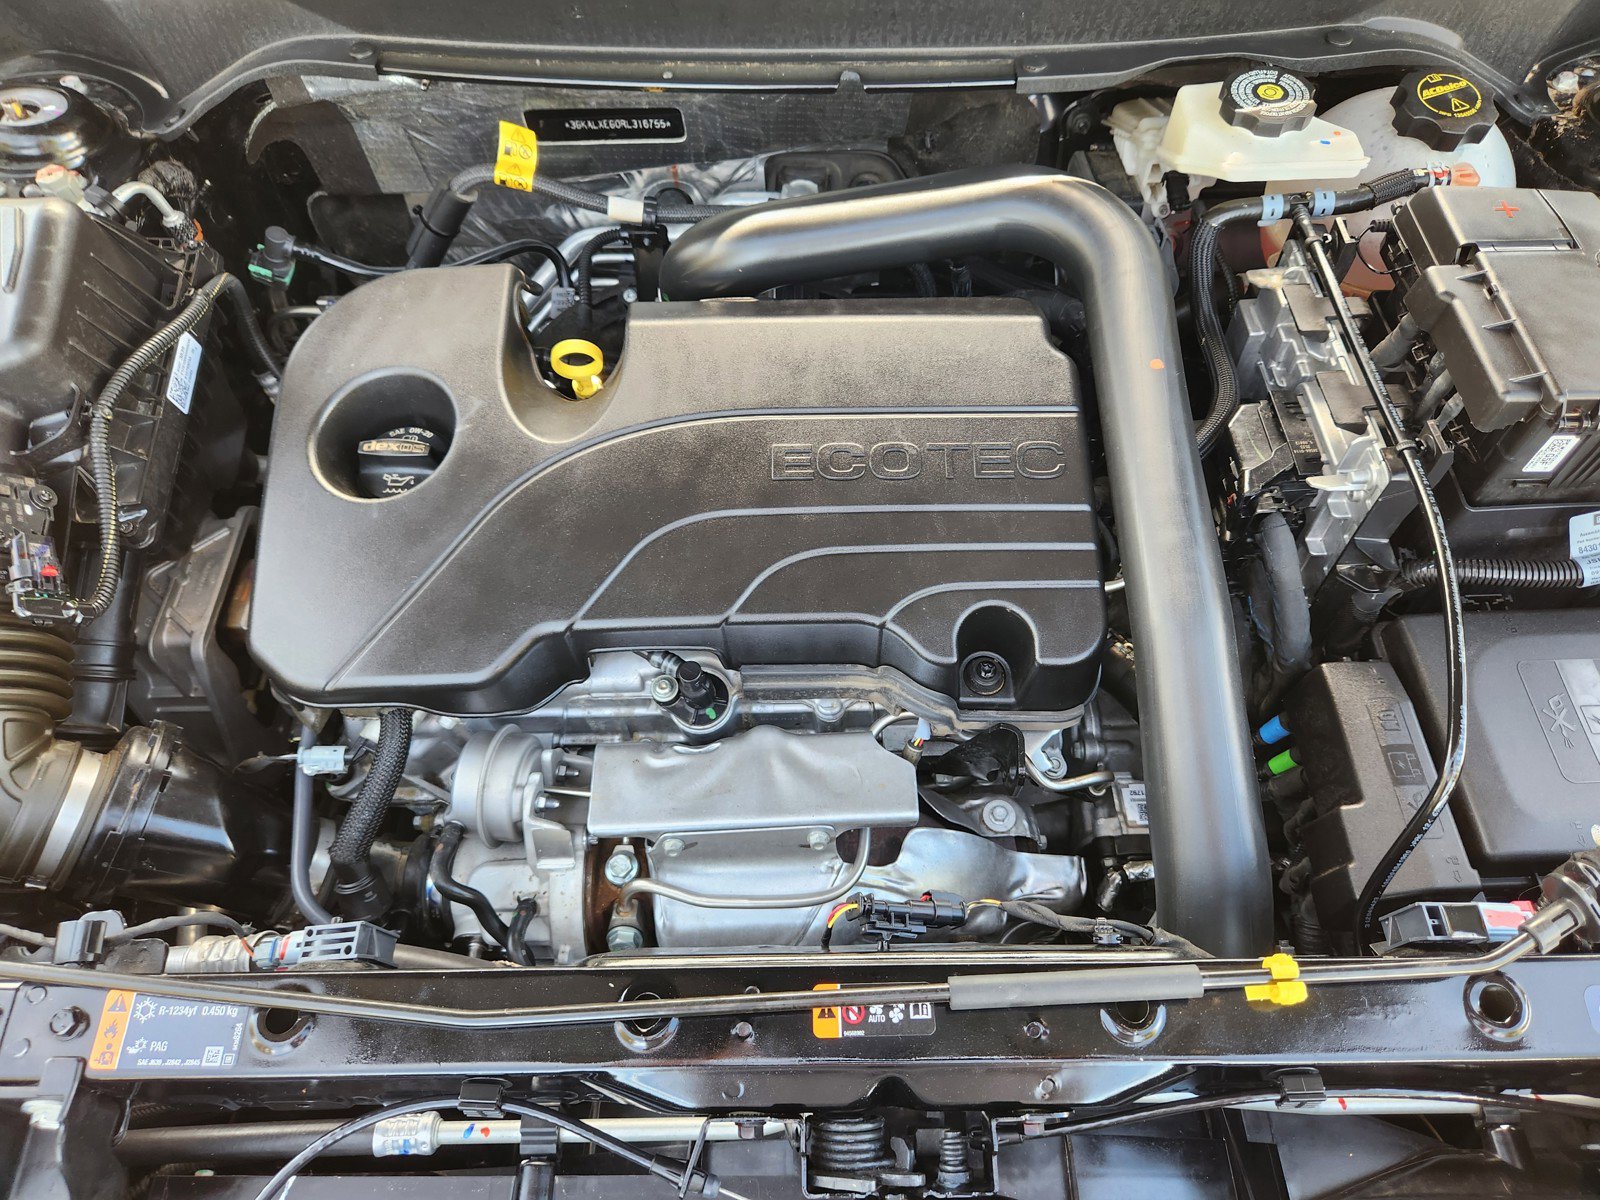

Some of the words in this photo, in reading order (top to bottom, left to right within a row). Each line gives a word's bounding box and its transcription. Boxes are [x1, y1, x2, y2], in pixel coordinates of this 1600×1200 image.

[1422, 80, 1467, 98] ACDelco
[389, 428, 405, 437] SAE
[362, 441, 426, 453] dexos
[771, 441, 1066, 481] ECOTEC
[158, 1005, 198, 1017] R-1234yf
[201, 1005, 226, 1016] 0.450
[226, 1006, 239, 1017] kg
[868, 1014, 886, 1023] AUTO
[149, 1040, 168, 1052] PAG
[136, 1058, 150, 1066] SAE
